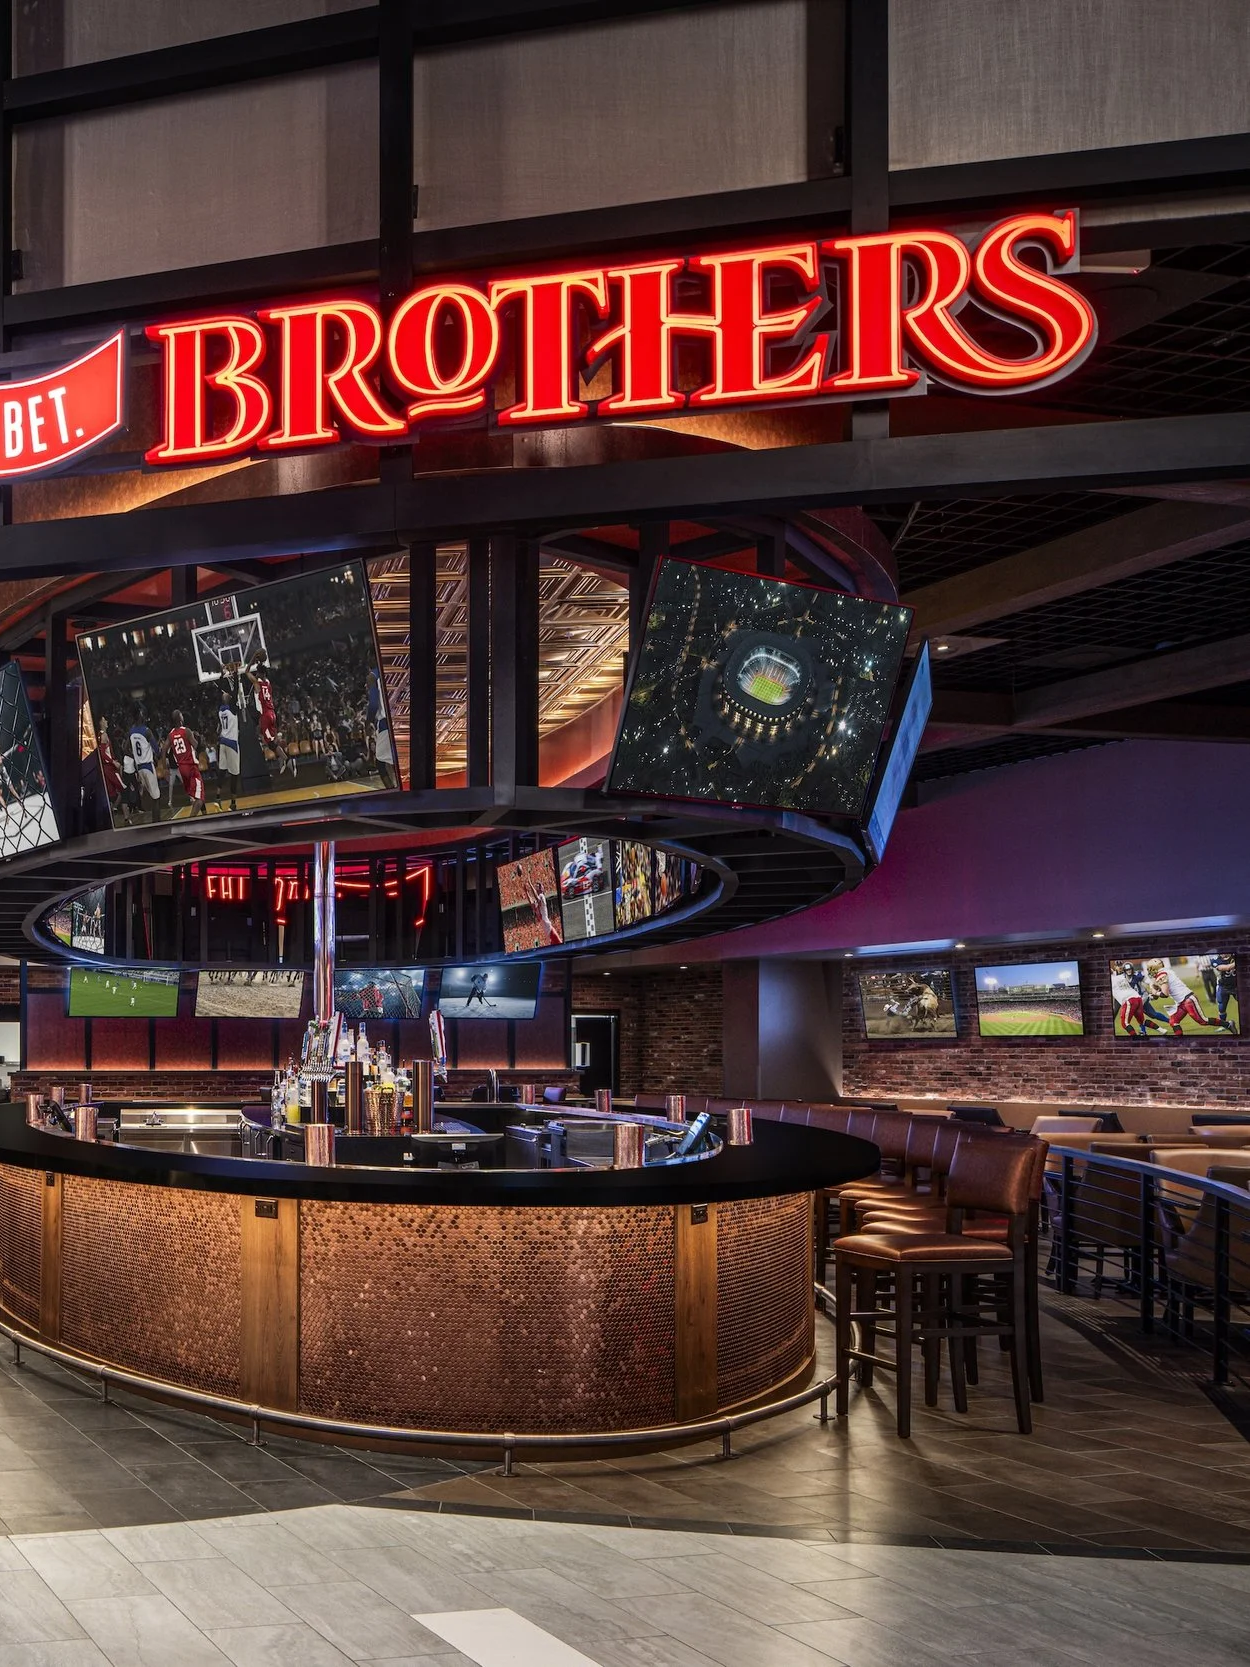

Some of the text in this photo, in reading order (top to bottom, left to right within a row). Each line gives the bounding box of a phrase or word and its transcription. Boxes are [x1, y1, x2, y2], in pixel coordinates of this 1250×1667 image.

[145, 209, 1098, 466] BROTHERS
[3, 386, 84, 459] BET.
[135, 740, 142, 757] 6
[173, 737, 187, 755] 23
